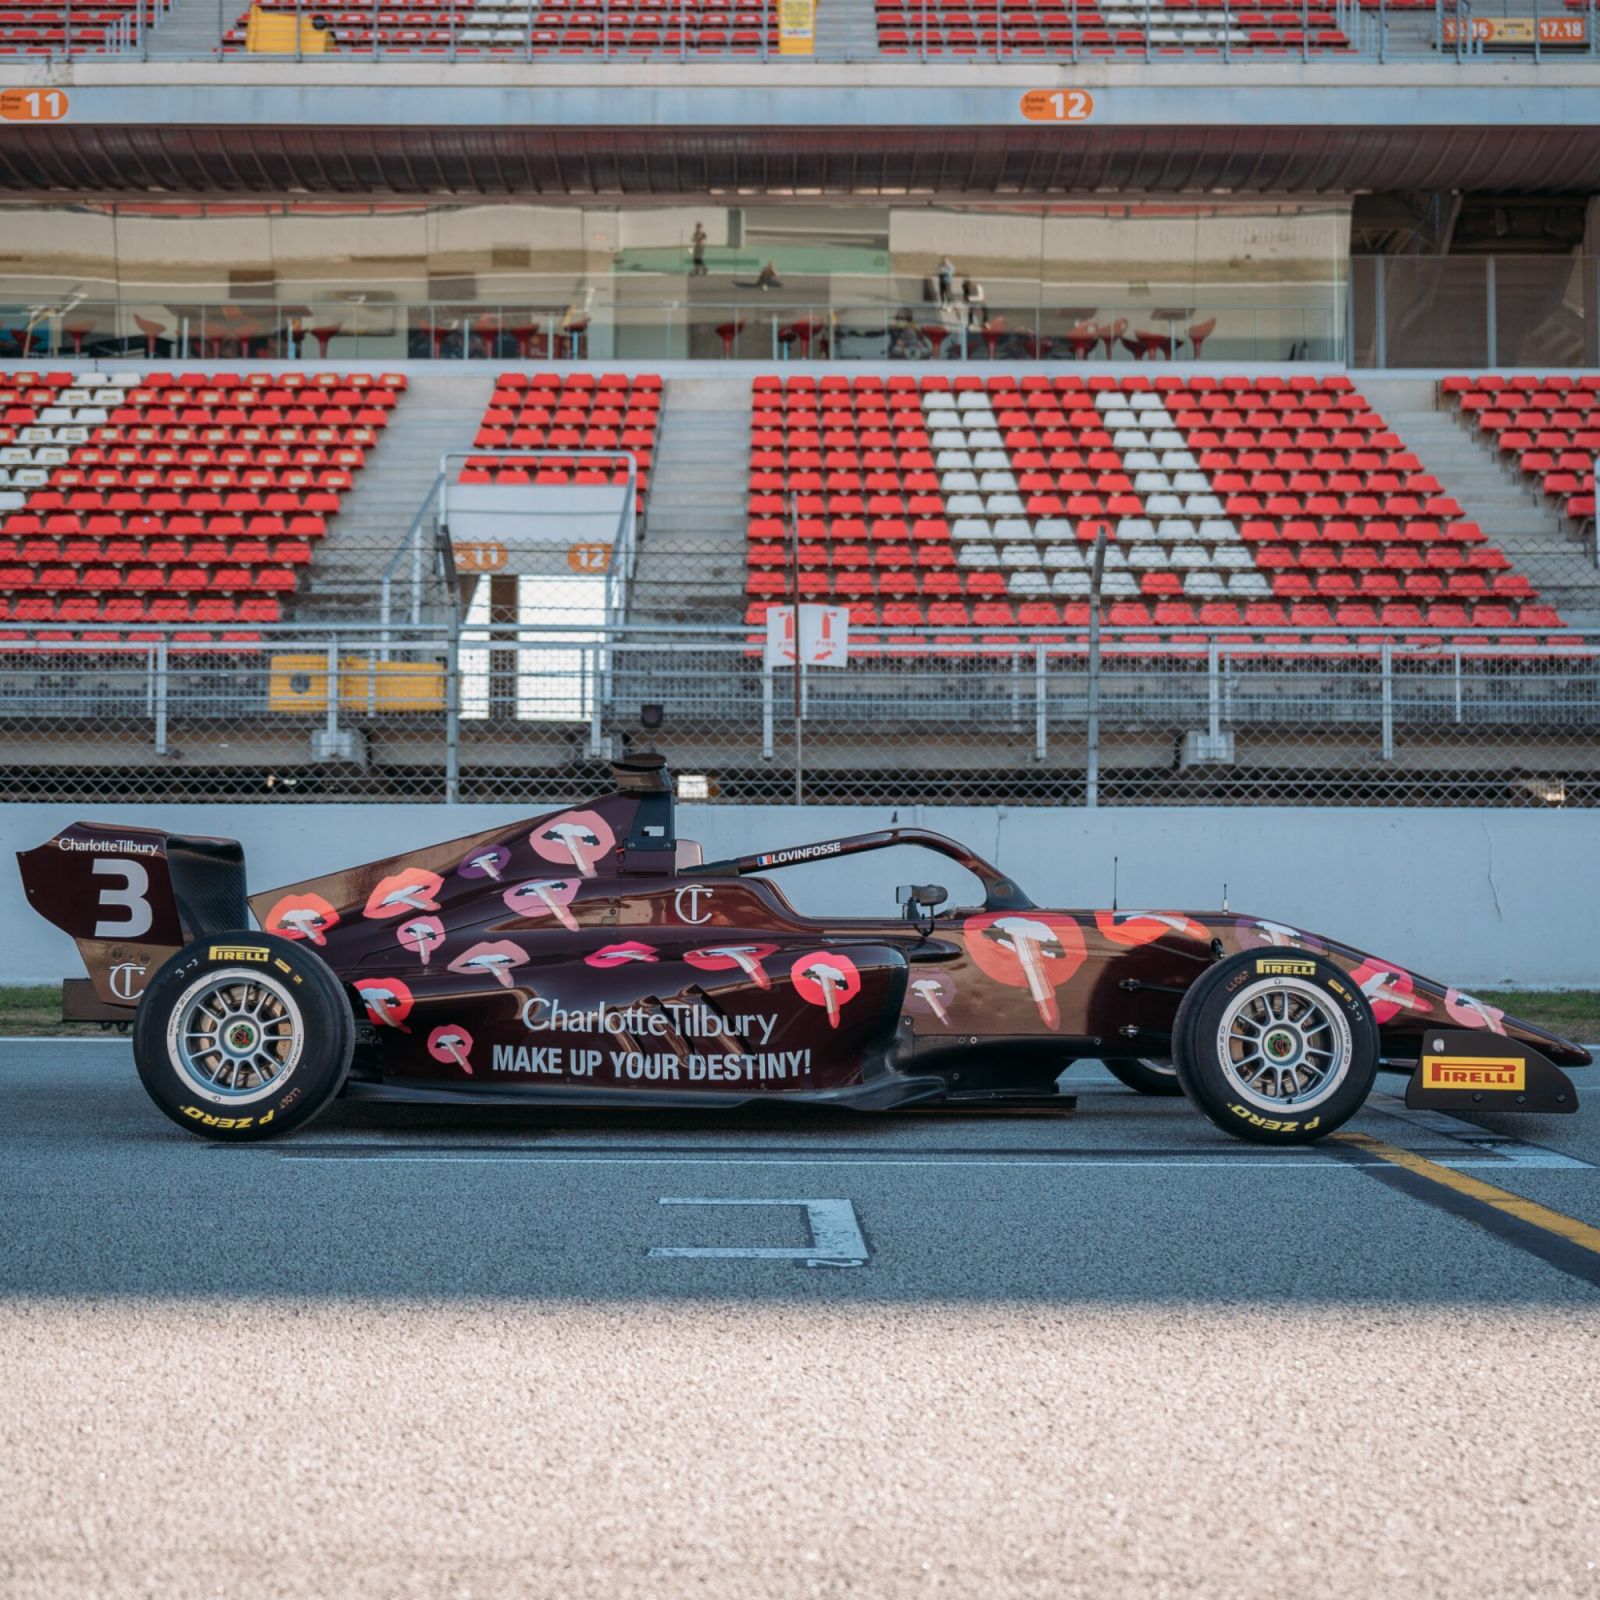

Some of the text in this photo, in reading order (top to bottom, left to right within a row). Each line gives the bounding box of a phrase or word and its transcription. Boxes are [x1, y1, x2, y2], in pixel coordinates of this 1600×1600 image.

[1540, 22, 1582, 38] 17.18
[26, 92, 59, 117] 11
[1049, 93, 1086, 118] 12
[474, 546, 499, 566] 11
[576, 548, 605, 568] 12
[58, 837, 160, 857] CharlotteTilbury
[771, 842, 842, 864] LOVINFOSSE
[92, 858, 153, 938] 3
[208, 946, 271, 962] PIRELLI
[1256, 959, 1317, 976] PIRELLI
[521, 997, 778, 1045] CharlotteTilbury
[492, 1045, 812, 1081] MAKE UP YOUR DESTINY!
[1431, 1062, 1516, 1084] PIRELLI
[183, 1105, 275, 1129] P ZERO
[1230, 1103, 1321, 1132] P ZERO
